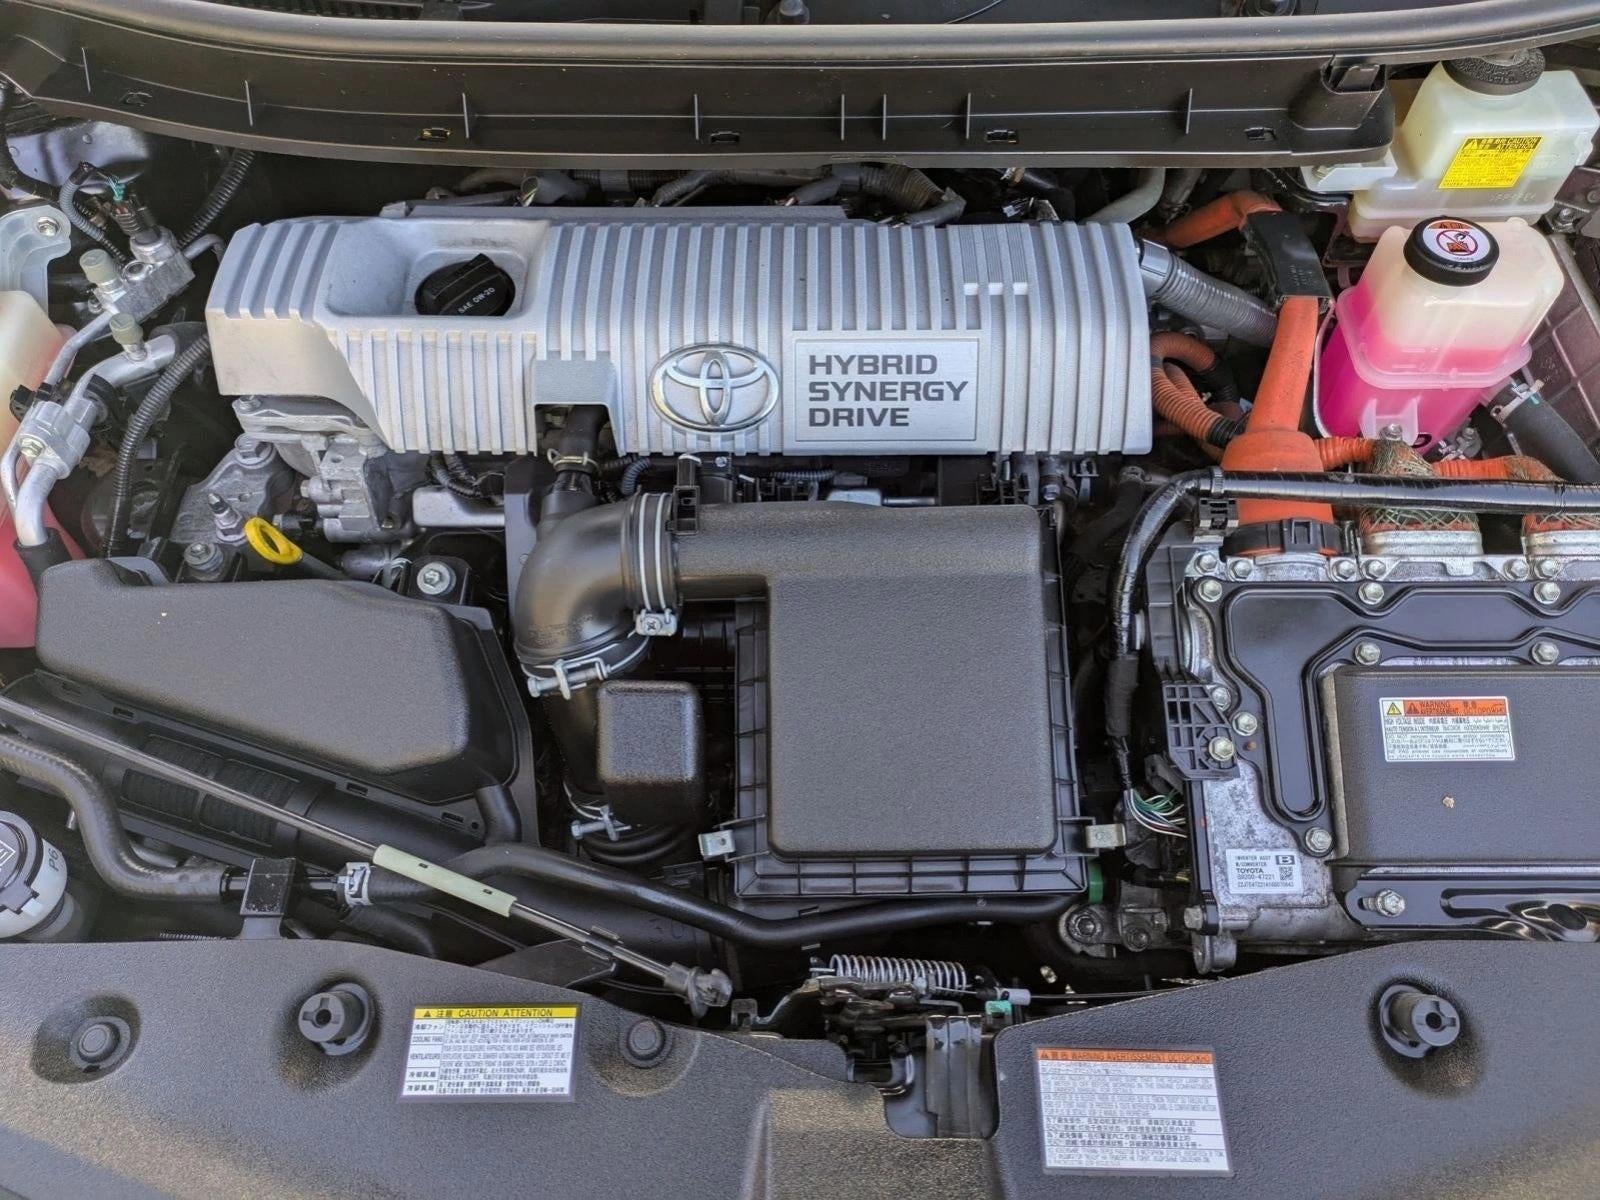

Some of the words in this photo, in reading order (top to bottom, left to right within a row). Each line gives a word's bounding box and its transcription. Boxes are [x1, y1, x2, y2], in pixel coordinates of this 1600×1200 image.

[457, 301, 473, 314] SAE
[472, 287, 496, 303] 0W-20
[809, 354, 938, 375] HYBRID
[808, 381, 969, 402] SYNERGY
[808, 407, 910, 427] DRIVE
[1420, 700, 1451, 708] WARNING
[458, 1009, 499, 1017] CAUTION
[503, 1009, 553, 1017] ATTENTION
[1071, 1052, 1105, 1062] WARNING
[1107, 1053, 1167, 1063] AVERTISSEMENT
